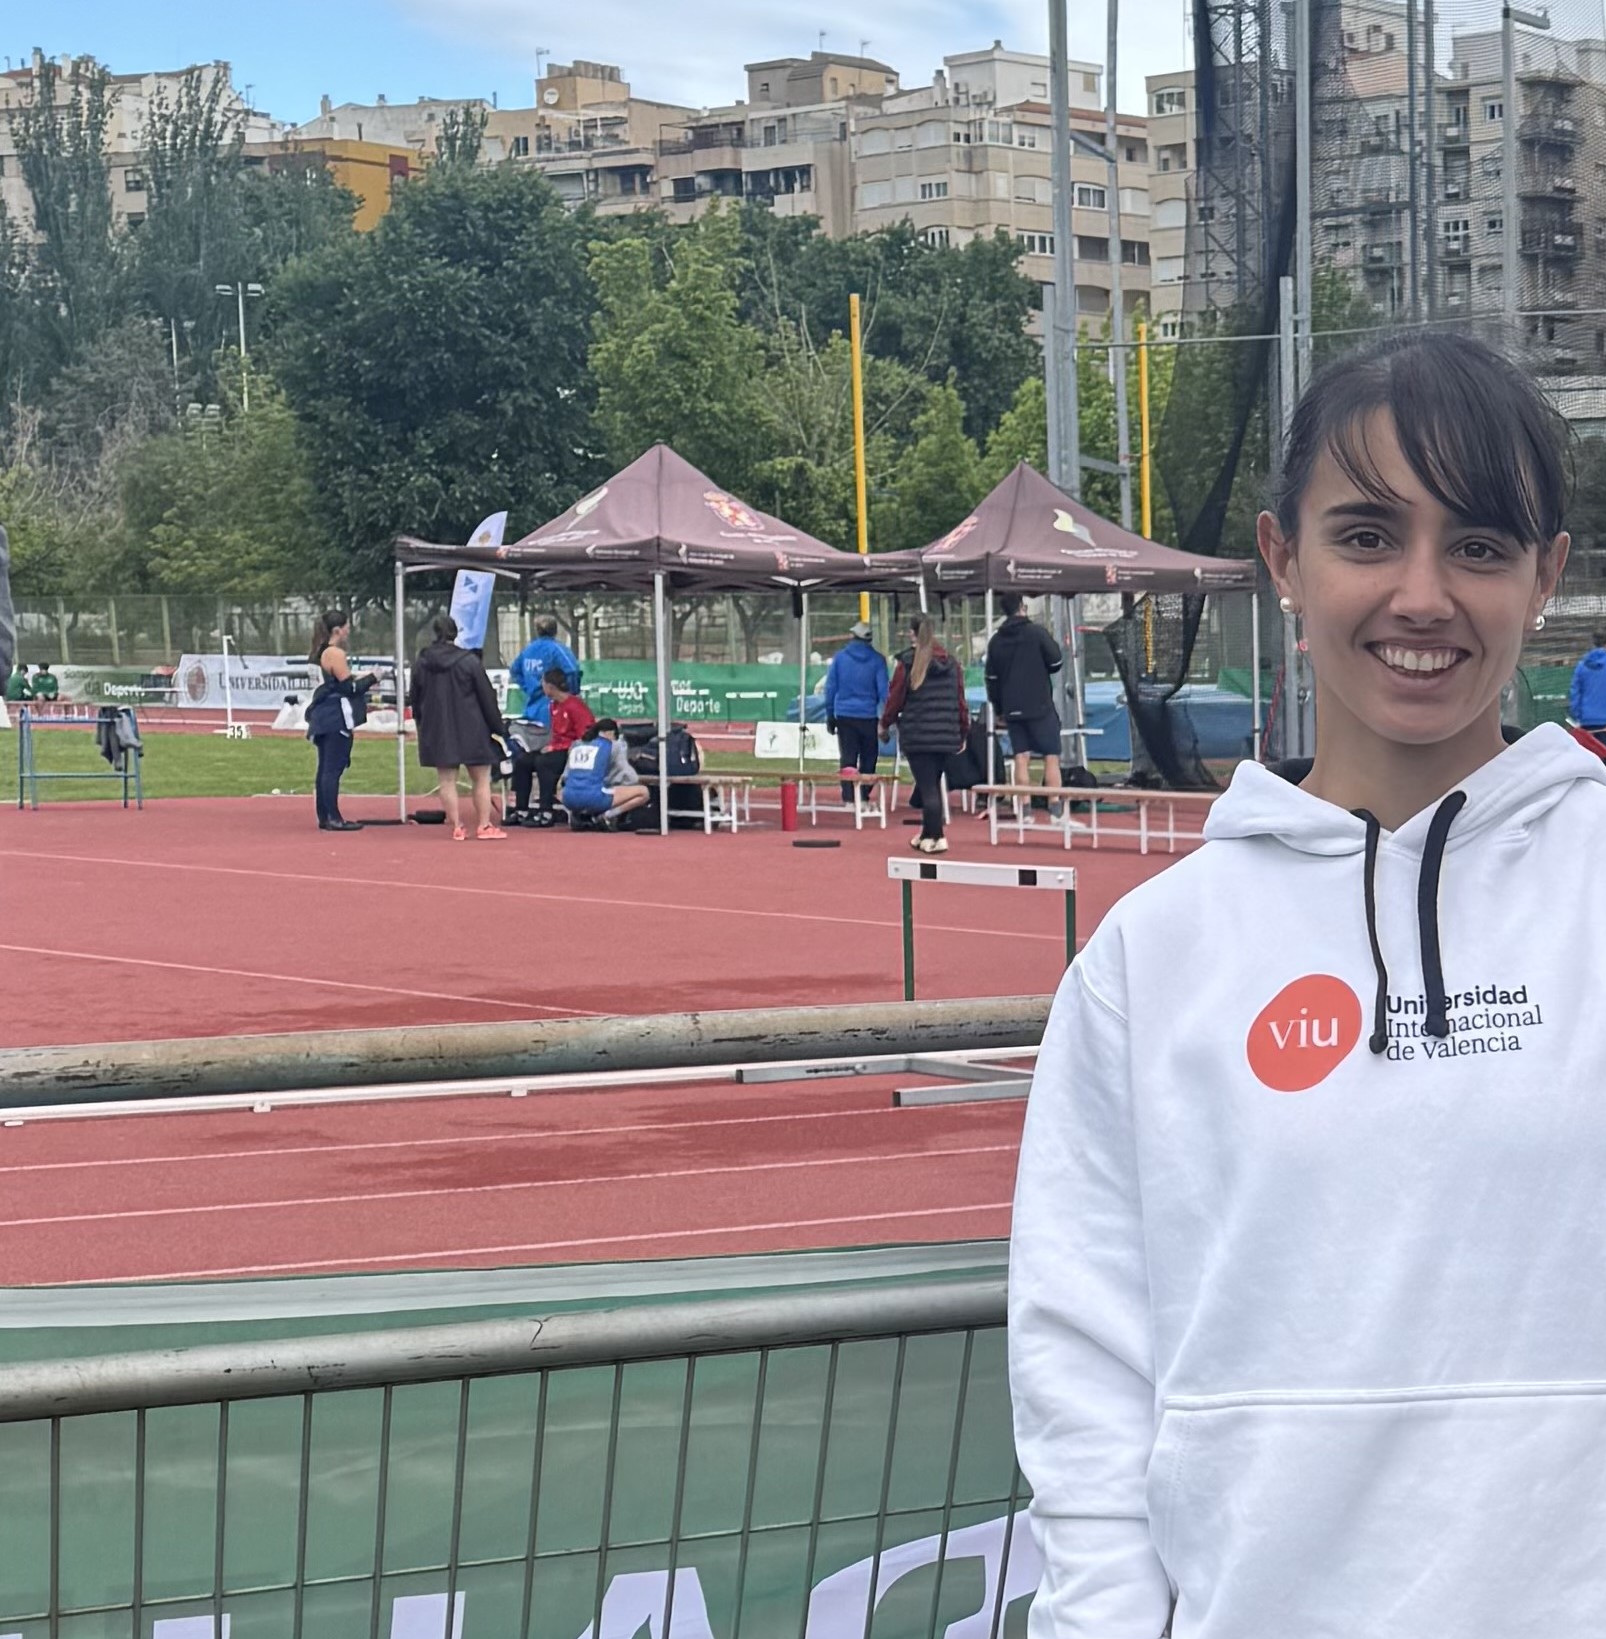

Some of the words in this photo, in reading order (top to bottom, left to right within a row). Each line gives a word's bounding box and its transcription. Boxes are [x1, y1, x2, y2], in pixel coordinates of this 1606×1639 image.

[1386, 984, 1528, 1015] Uniersidad
[1267, 1007, 1339, 1050] viu
[1387, 1004, 1544, 1038] Intenacional
[1386, 1040, 1415, 1061] de
[1422, 1031, 1523, 1060] Valencia
